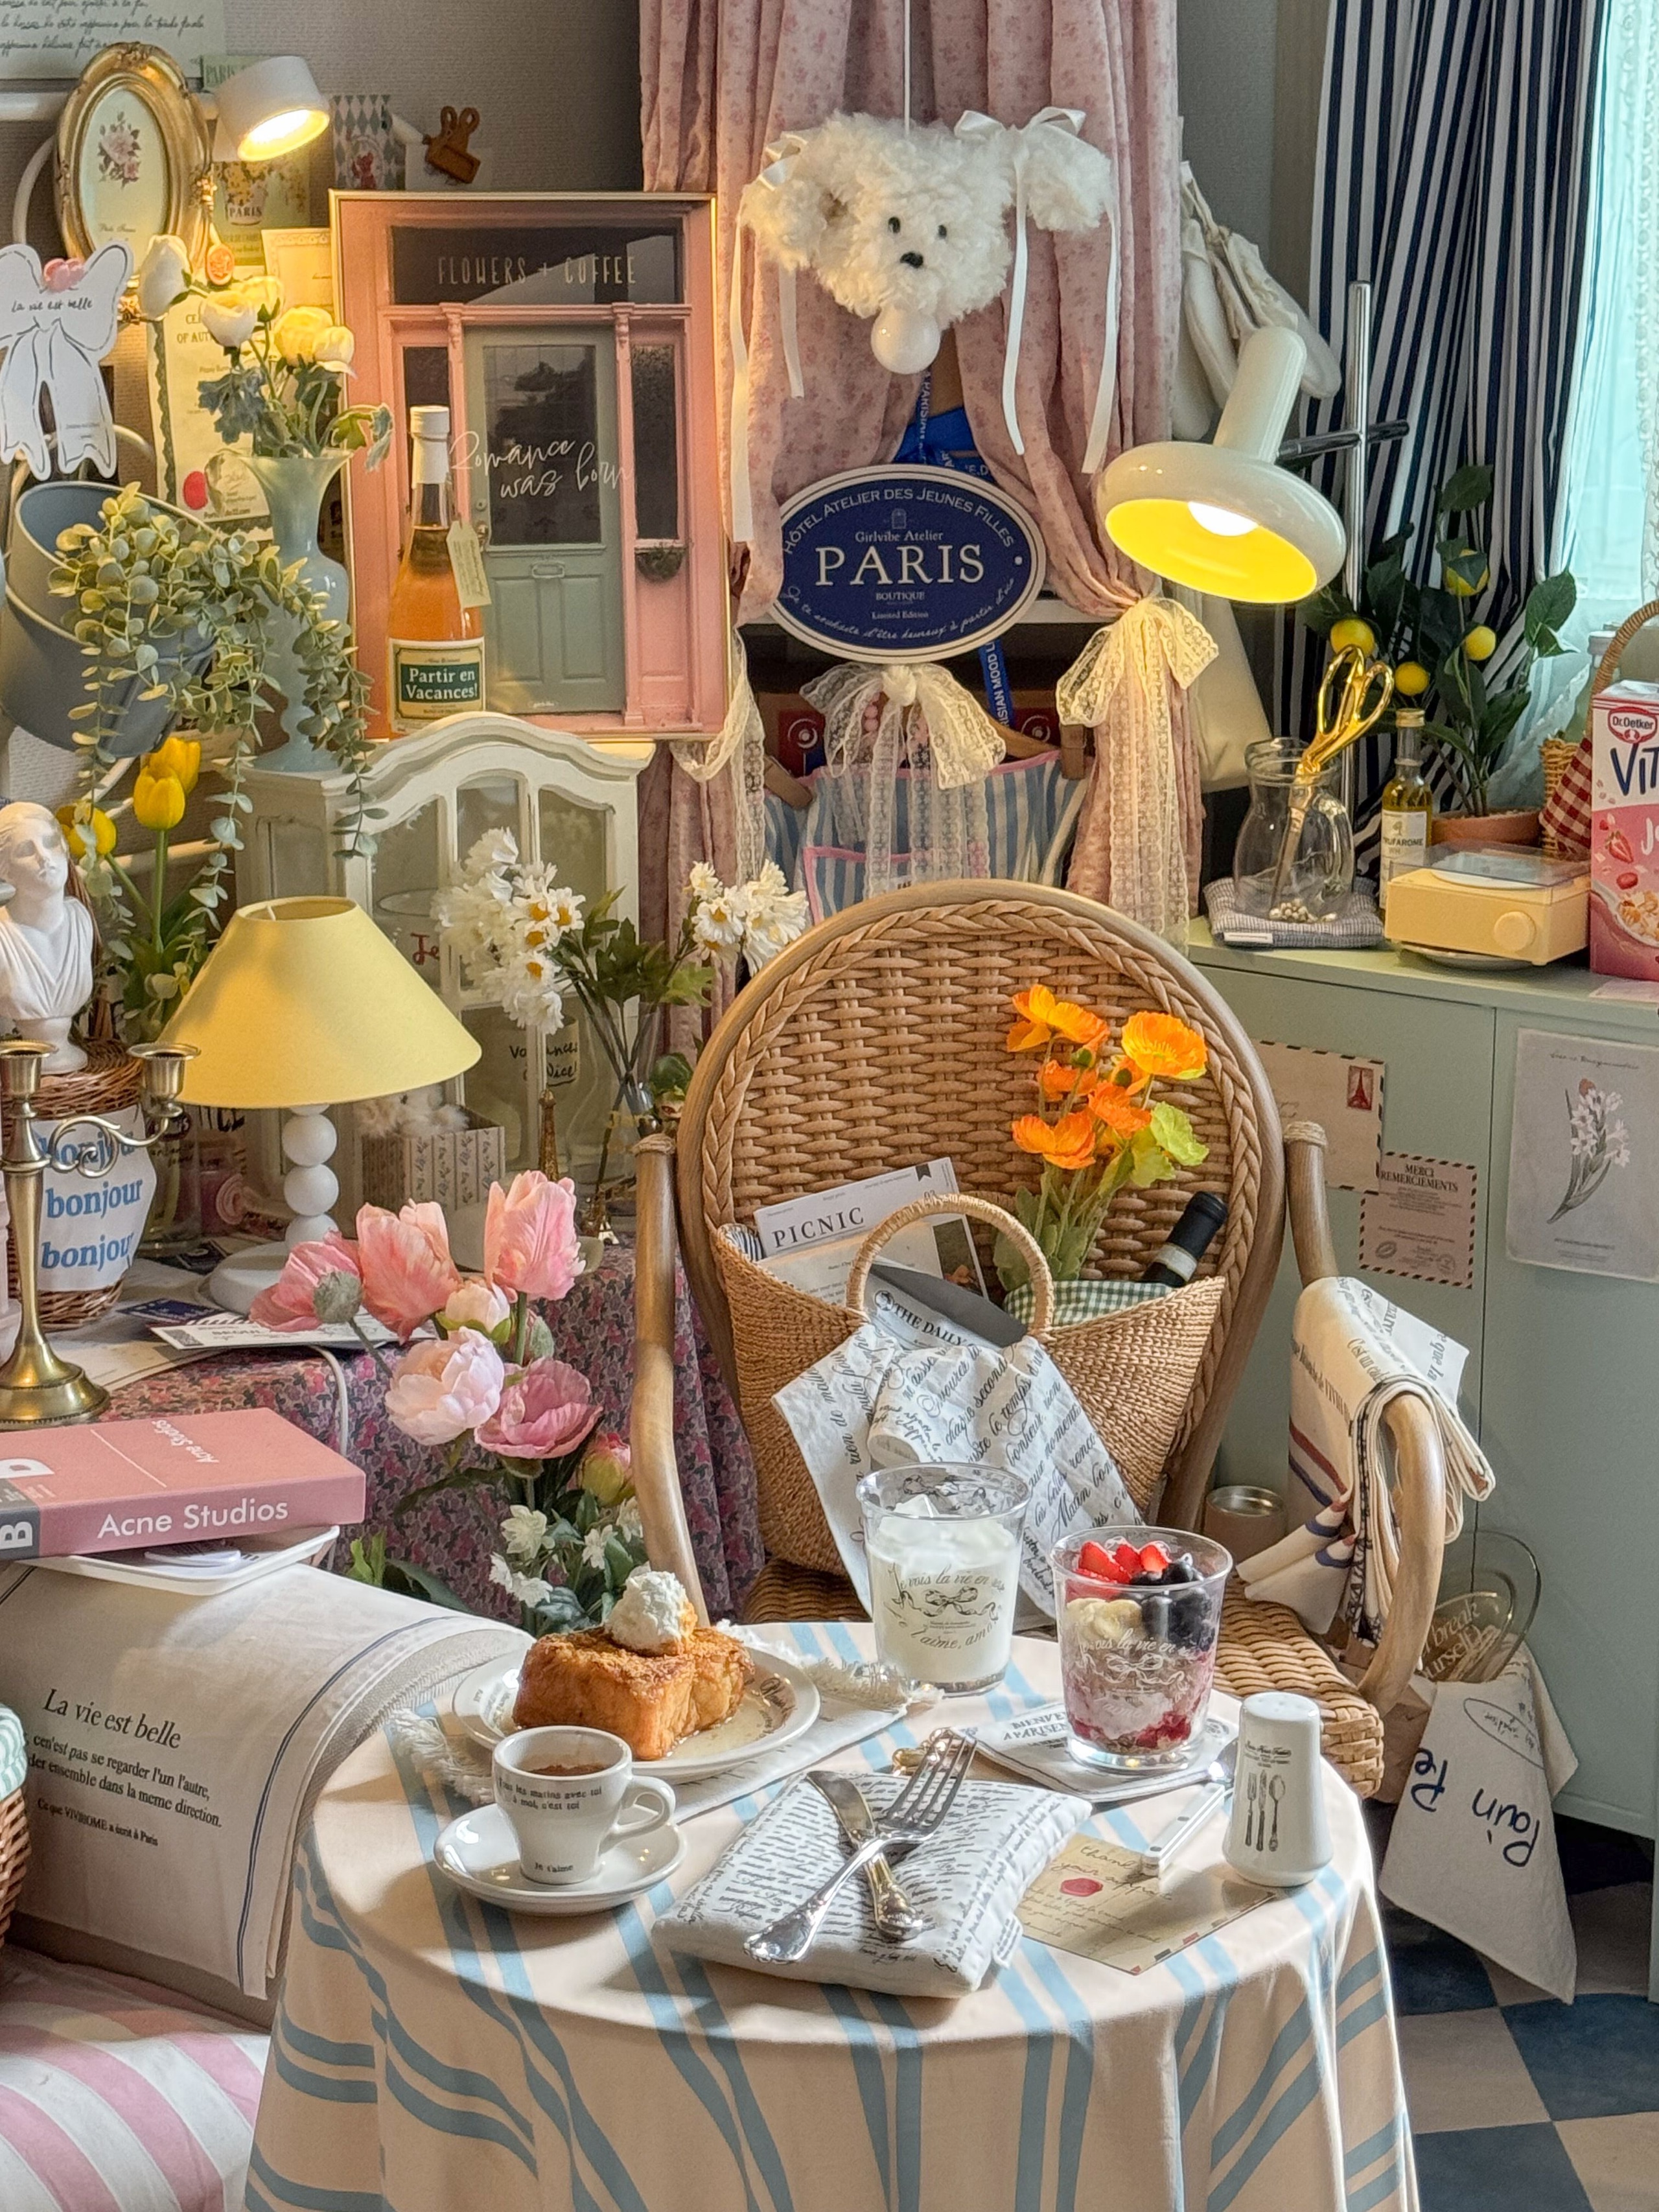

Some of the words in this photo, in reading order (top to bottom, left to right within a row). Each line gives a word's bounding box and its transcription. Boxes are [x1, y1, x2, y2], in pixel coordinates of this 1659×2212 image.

[229, 207, 262, 217] PARIS
[439, 257, 526, 285] FLOWERS
[564, 256, 636, 285] COFFEE
[448, 430, 577, 477] Romance
[500, 469, 563, 499] was
[823, 490, 881, 518] ATELIER
[884, 487, 913, 500] DES
[916, 487, 975, 513] JEUNES
[974, 504, 1015, 548] FILLES
[903, 529, 944, 542] Atelier
[814, 544, 984, 587] PARIS
[875, 591, 925, 601] BOUTIQUE
[405, 682, 478, 700] Vacances!
[409, 668, 456, 683] Partir
[459, 669, 475, 682] en
[987, 653, 1003, 690] MOOD
[1380, 1170, 1458, 1192] REMERCIEMENTS
[1405, 1164, 1434, 1177] MERCI
[45, 1178, 143, 1219] bonjour
[771, 1206, 864, 1249] PICNIC
[892, 1303, 923, 1329] THE
[922, 1321, 966, 1347] DAILY
[97, 1513, 173, 1539] Acne
[183, 1497, 289, 1530] Studios
[43, 1688, 69, 1716] La
[75, 1701, 102, 1727] vie
[104, 1714, 135, 1735] est
[134, 1713, 182, 1749] belle
[68, 1747, 88, 1761] pas
[91, 1754, 105, 1765] se
[106, 1756, 150, 1780] regarder
[152, 1767, 175, 1787] l'un
[177, 1773, 211, 1800] l'autre,
[49, 1762, 97, 1787] ensemble
[99, 1775, 124, 1795] dans
[126, 1782, 137, 1799] la
[174, 1799, 222, 1828] direction.
[564, 1791, 587, 1799] avec
[49, 1804, 63, 1815] que
[139, 1830, 159, 1846] Paris
[1471, 1788, 1540, 1868] Pain
[533, 1862, 544, 1872] Je
[547, 1864, 574, 1873] t'aime
